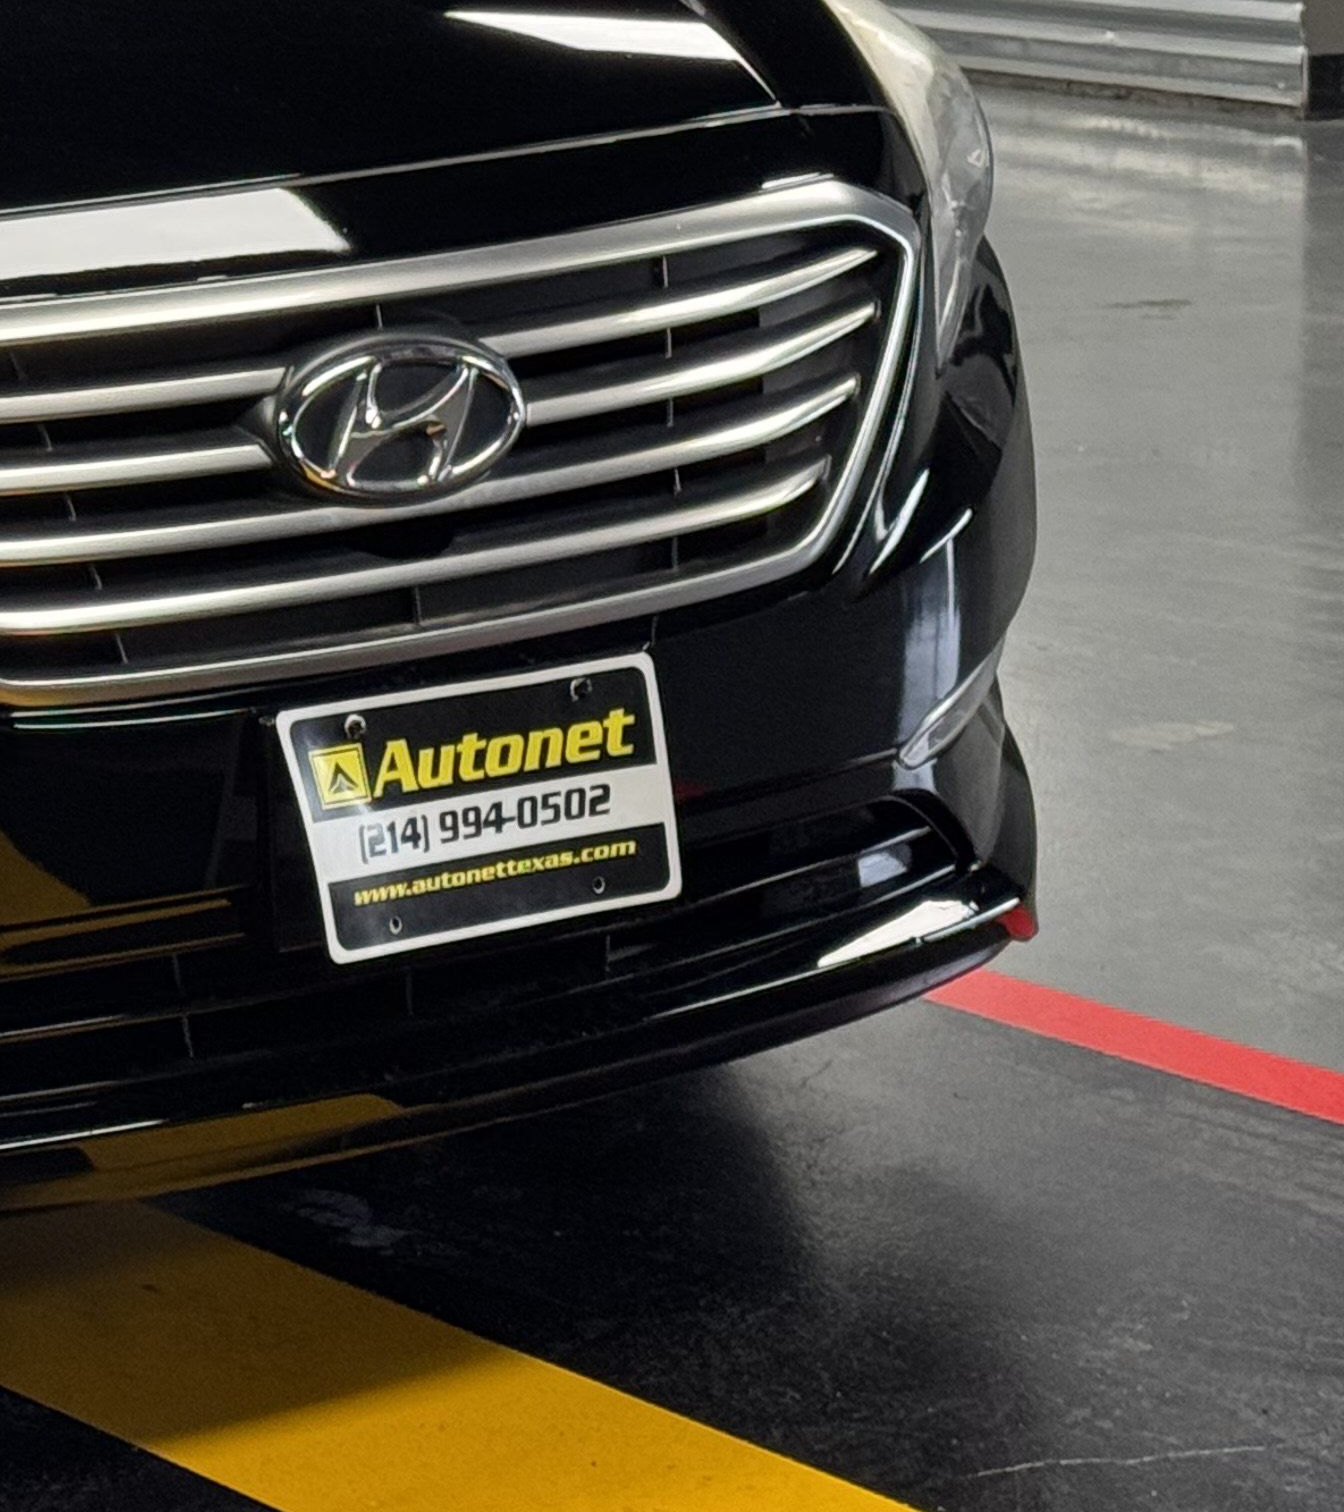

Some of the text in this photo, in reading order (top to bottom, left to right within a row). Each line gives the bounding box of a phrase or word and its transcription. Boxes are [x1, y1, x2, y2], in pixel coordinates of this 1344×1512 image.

[372, 707, 636, 800] Autonet
[358, 783, 612, 865] (214) 994-0502
[353, 839, 637, 906] www.autonettexas.com
